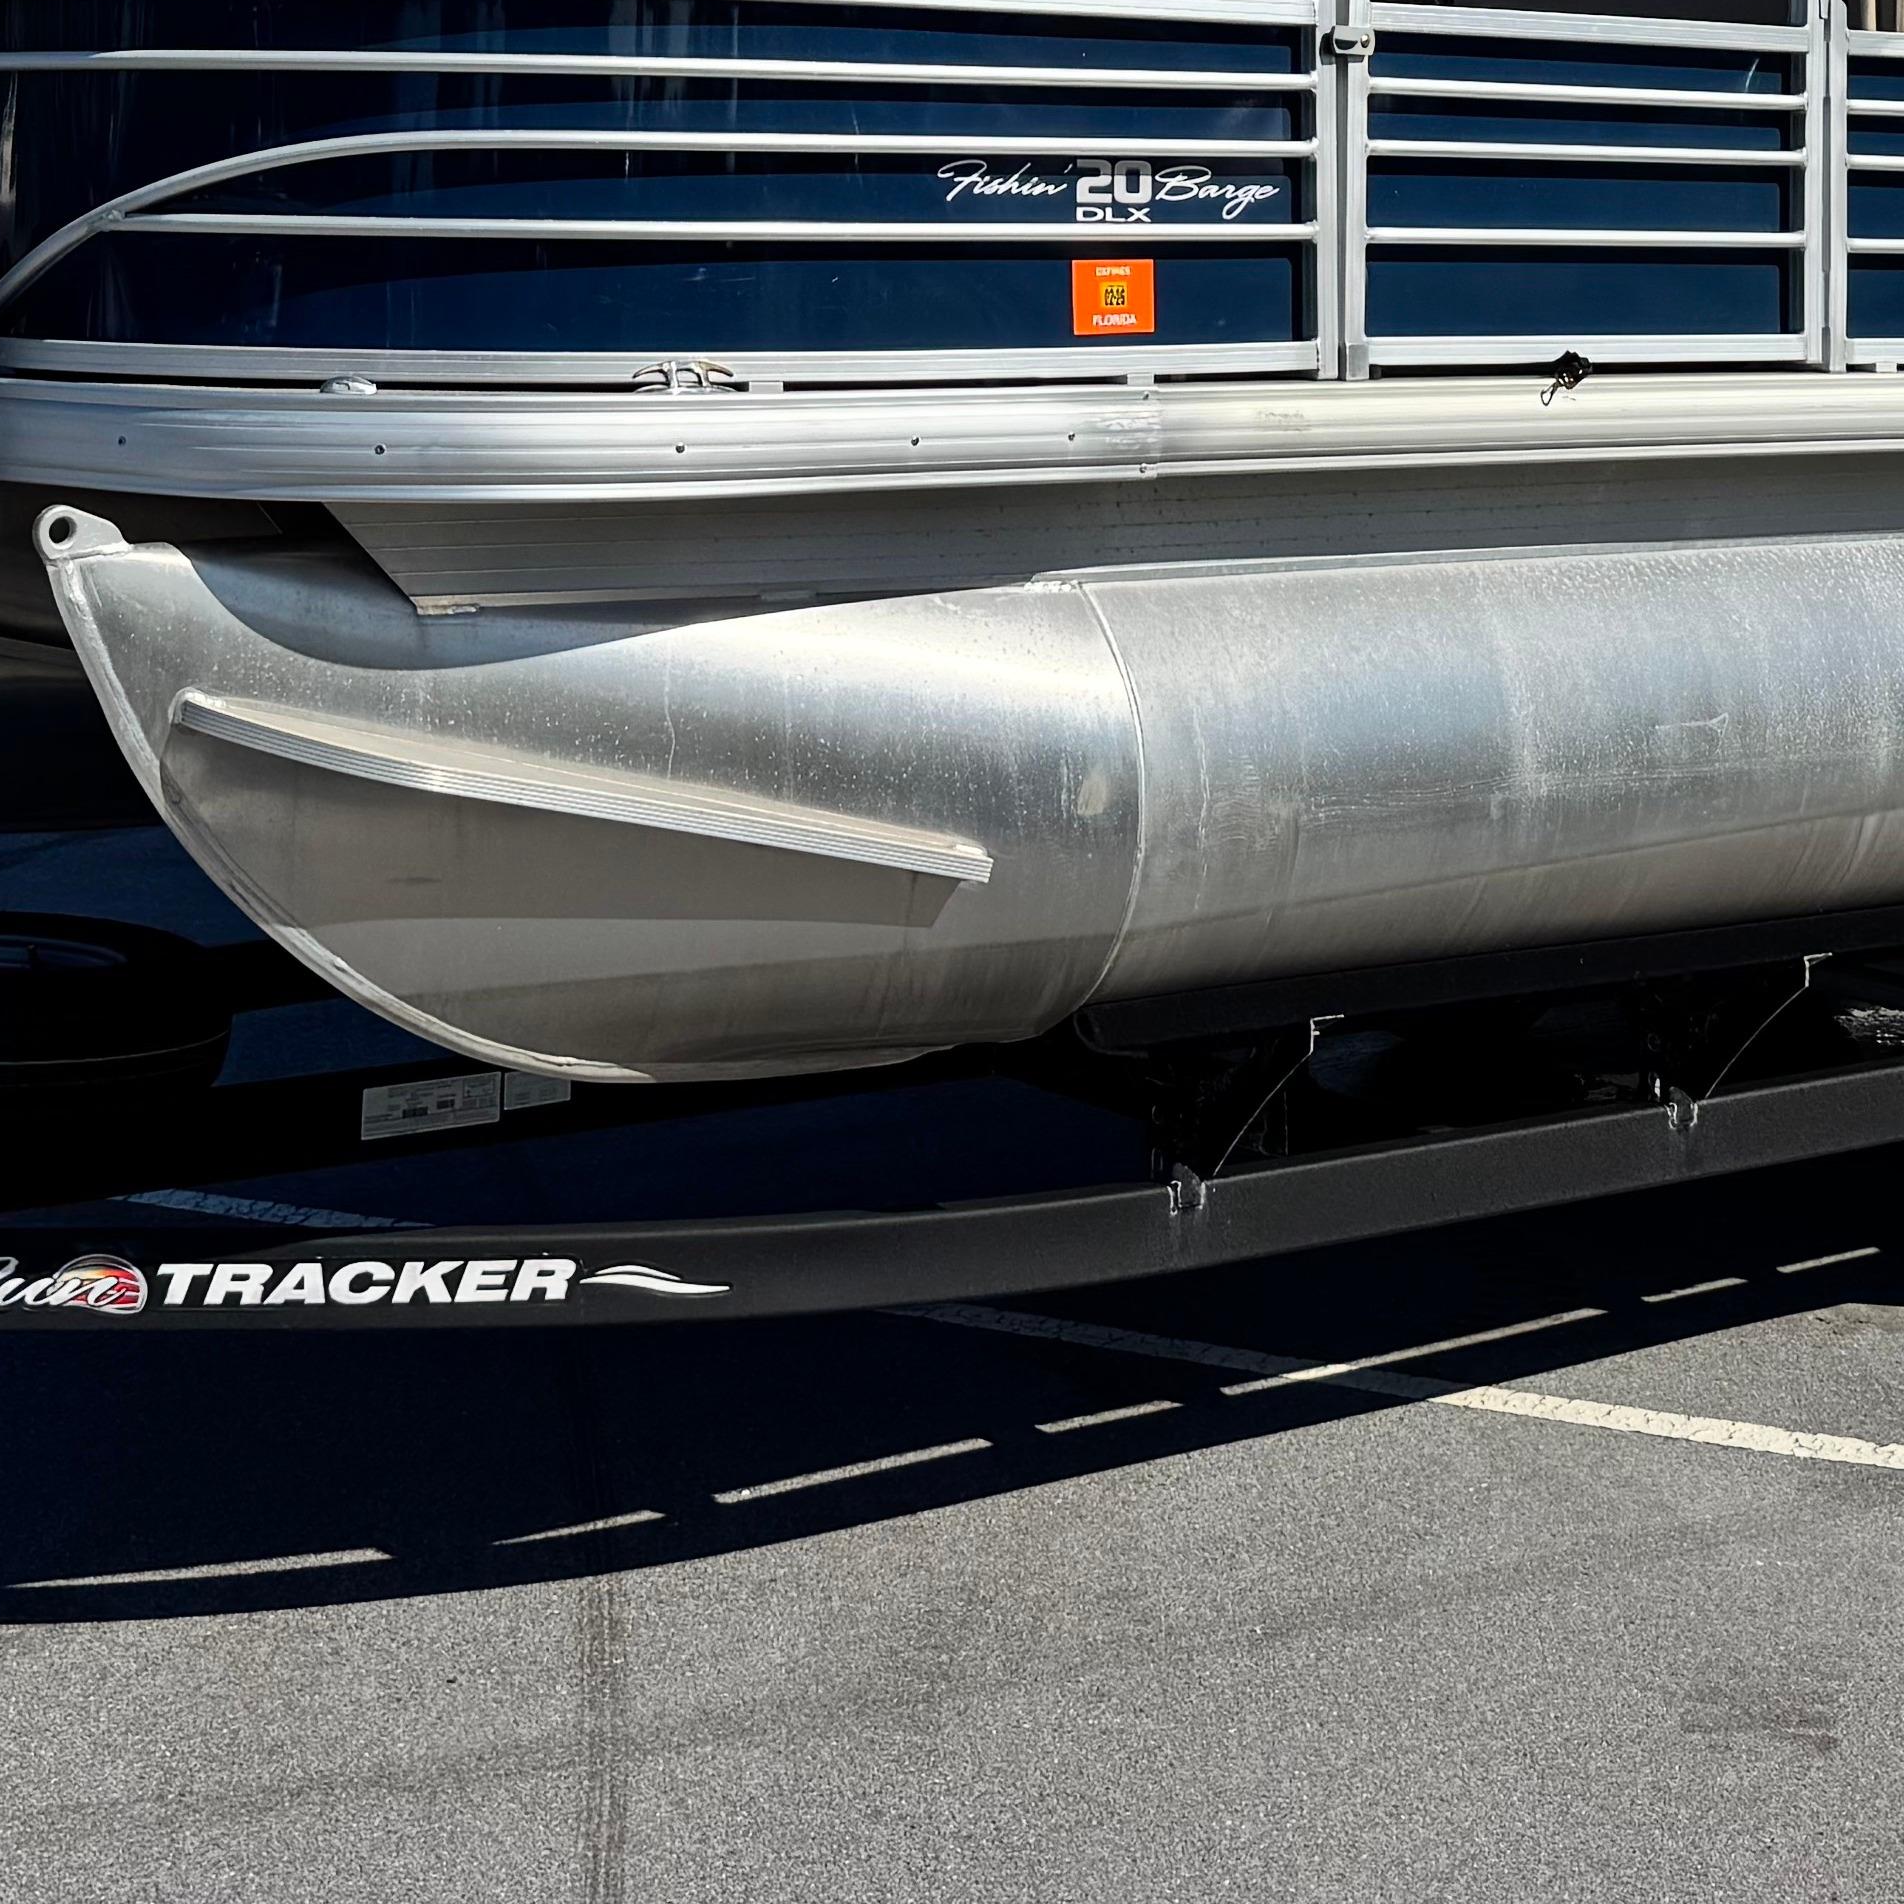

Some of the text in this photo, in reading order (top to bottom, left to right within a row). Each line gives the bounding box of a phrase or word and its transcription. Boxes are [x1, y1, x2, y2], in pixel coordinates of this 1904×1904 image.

[1075, 158, 1153, 204] 20
[1154, 165, 1281, 220] Barge
[1075, 206, 1152, 223] DLX
[154, 1259, 580, 1307] TRACKER
